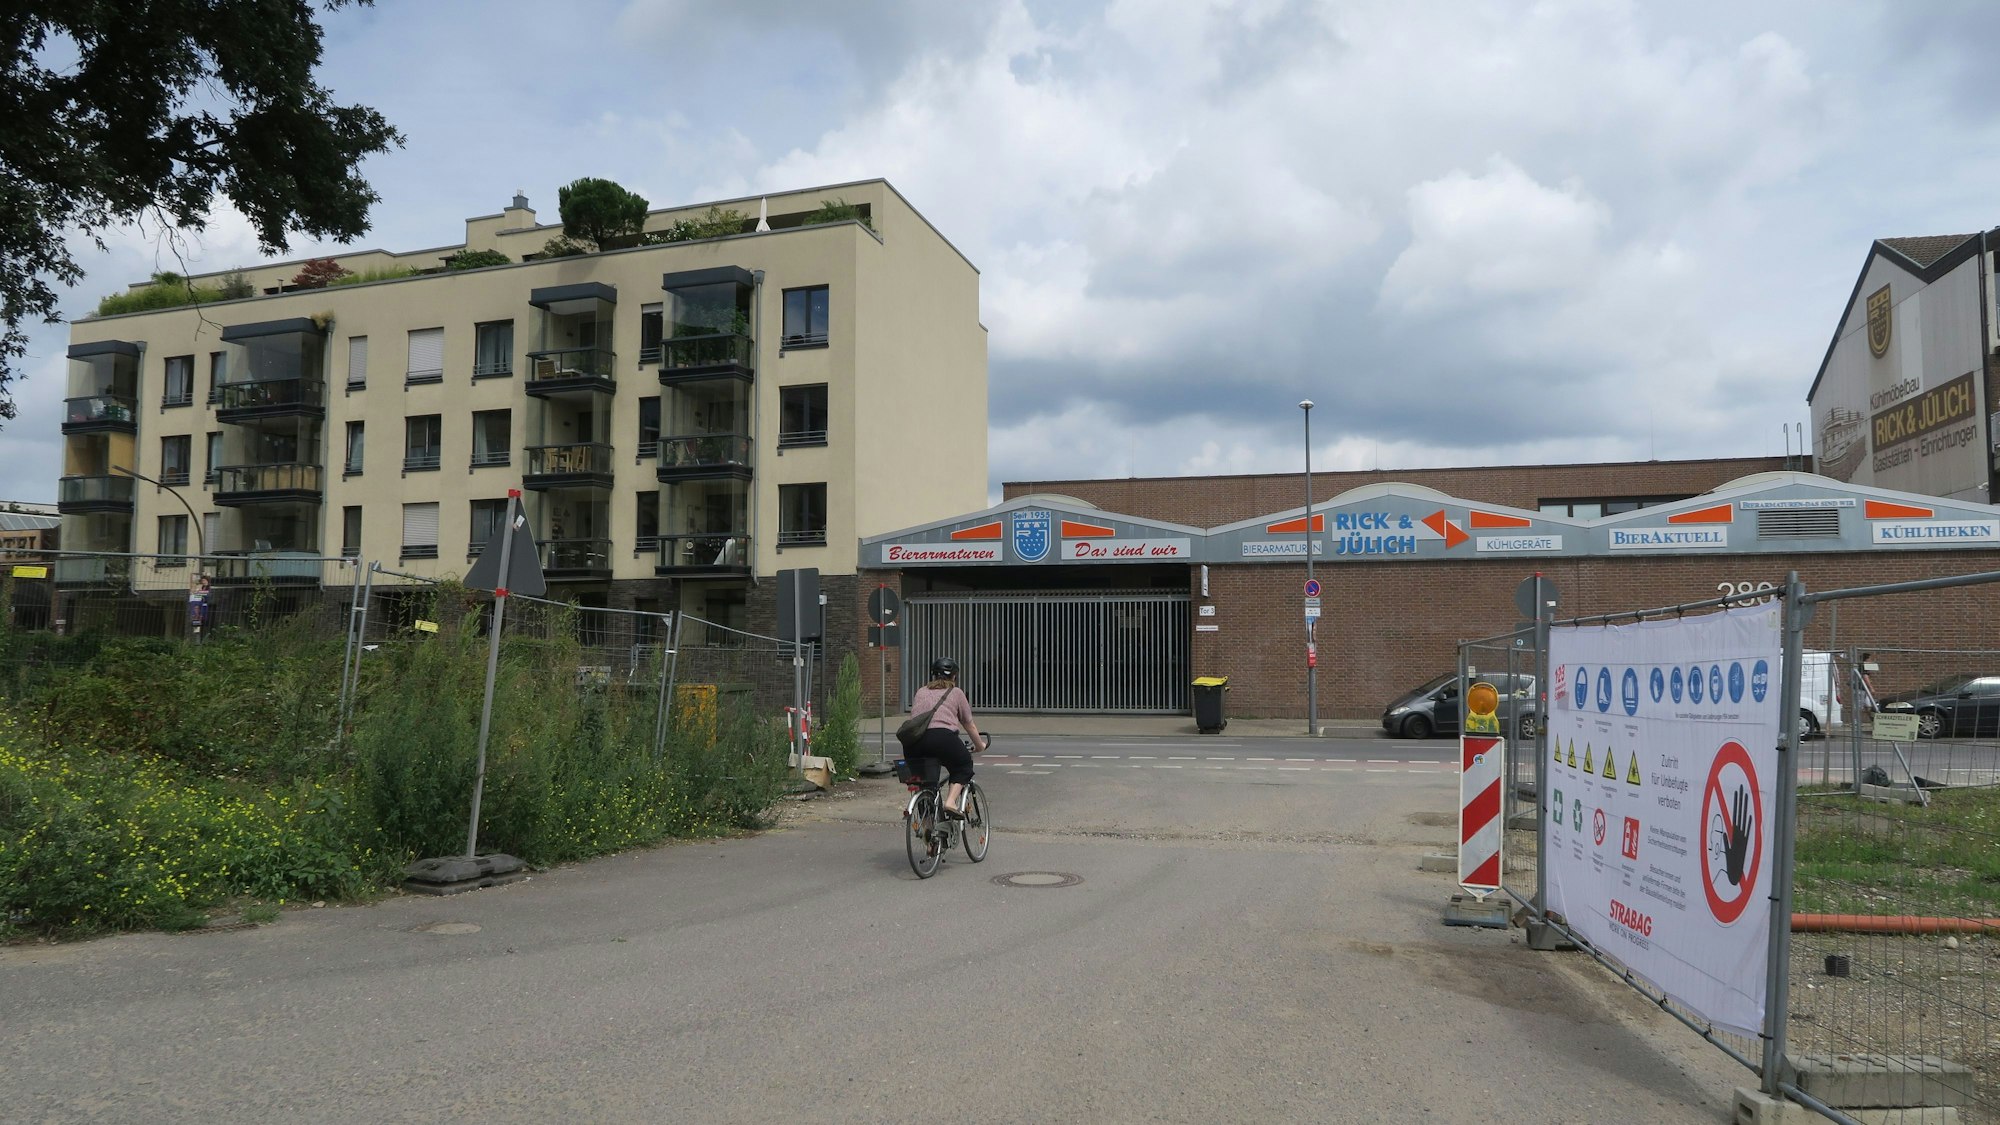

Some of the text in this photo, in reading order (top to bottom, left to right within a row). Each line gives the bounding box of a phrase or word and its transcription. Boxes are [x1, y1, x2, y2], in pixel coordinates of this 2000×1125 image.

[1875, 381, 1970, 446] RICK & JÜLICH
[1873, 448, 1913, 473] Gaststätten
[1921, 425, 1977, 457] Einrichtungen
[1031, 511, 1050, 519] 1955
[1337, 513, 1413, 530] RICK &
[1881, 525, 1991, 539] KÜHLTHEKEN
[1075, 543, 1177, 557] Das sind wir
[1243, 543, 1321, 555] BIERARMATURN
[1337, 532, 1417, 555] JÜLICH
[1487, 537, 1552, 549] KÜHLGERÄTE
[889, 546, 995, 560] Bierarmaturen
[1717, 581, 1775, 607] 280
[1661, 754, 1679, 769] Zutritt
[1651, 772, 1688, 793] für Unbefugte
[1658, 796, 1681, 810] verboten
[1610, 899, 1652, 937] STRABAG
